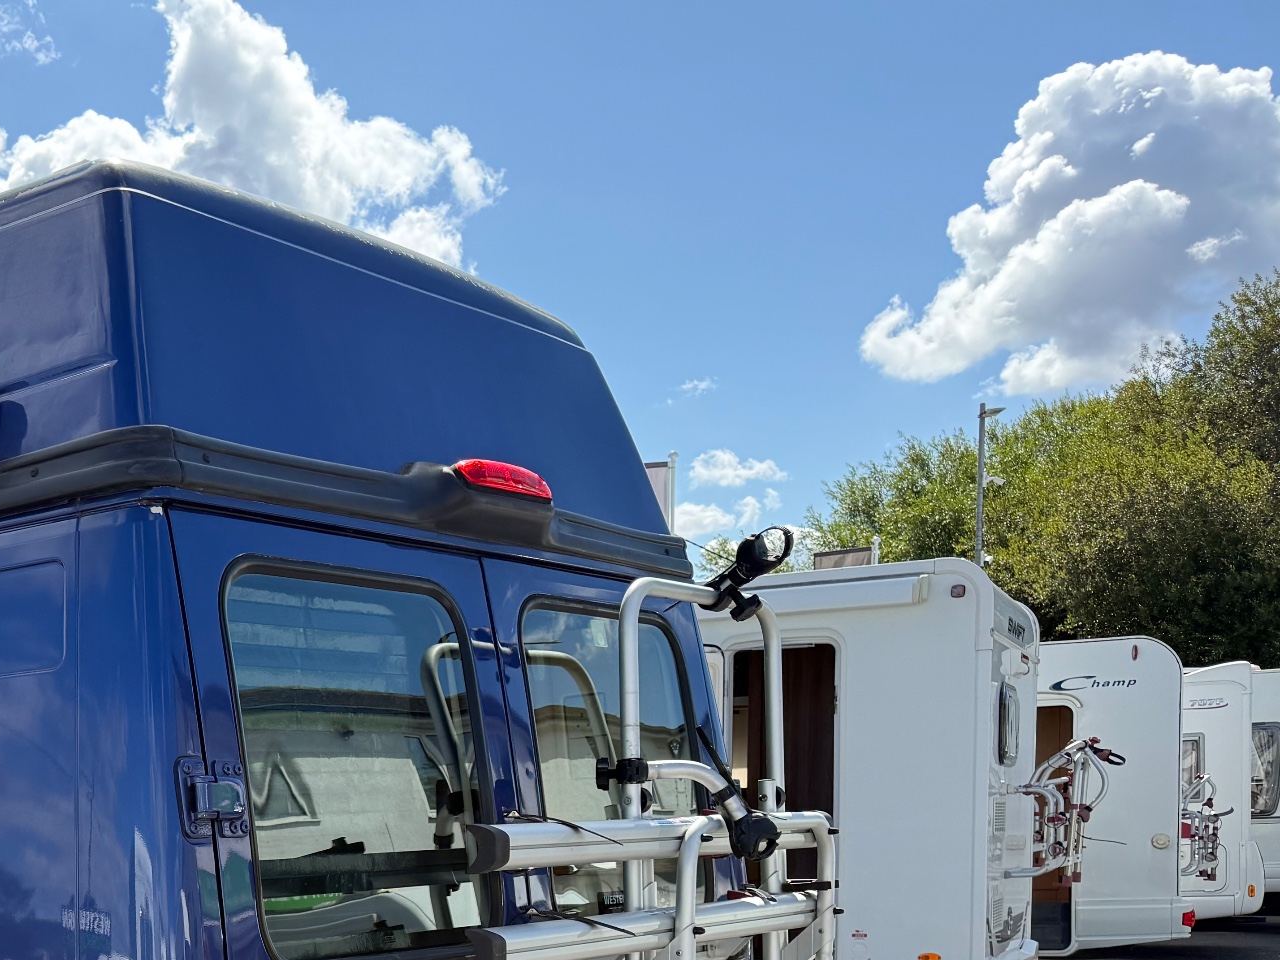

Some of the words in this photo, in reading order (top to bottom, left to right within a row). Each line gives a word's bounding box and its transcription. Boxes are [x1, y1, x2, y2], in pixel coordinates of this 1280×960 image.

[1008, 615, 1026, 643] SWIFT
[1049, 675, 1137, 691] Champ
[603, 894, 625, 905] WESTE
